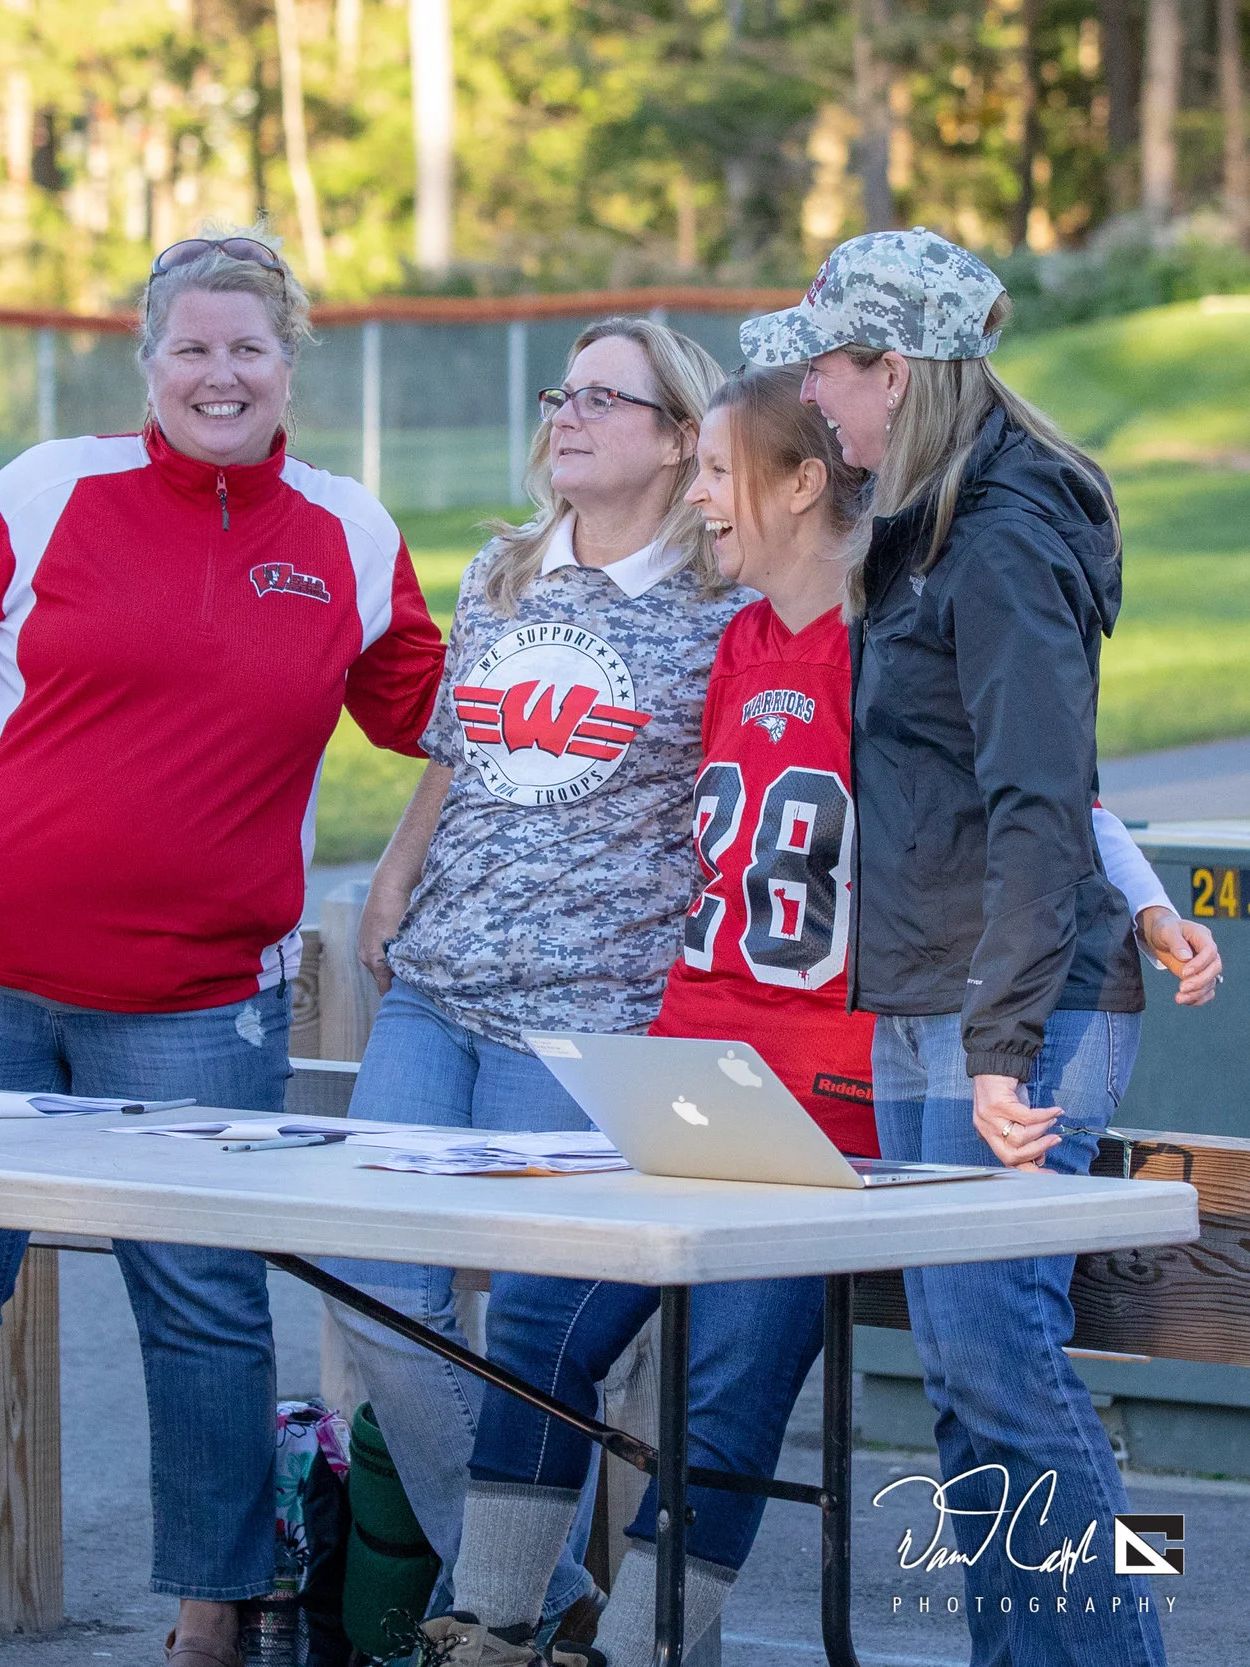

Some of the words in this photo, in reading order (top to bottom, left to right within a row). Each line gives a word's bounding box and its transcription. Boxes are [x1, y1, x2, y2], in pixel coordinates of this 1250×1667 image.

[479, 648, 502, 672] WE
[516, 626, 597, 651] SUPPORT
[741, 689, 816, 726] WARRIORS
[493, 782, 520, 798] OUR
[535, 769, 604, 805] TROOPS
[683, 762, 854, 990] 28
[1188, 867, 1250, 917] 24
